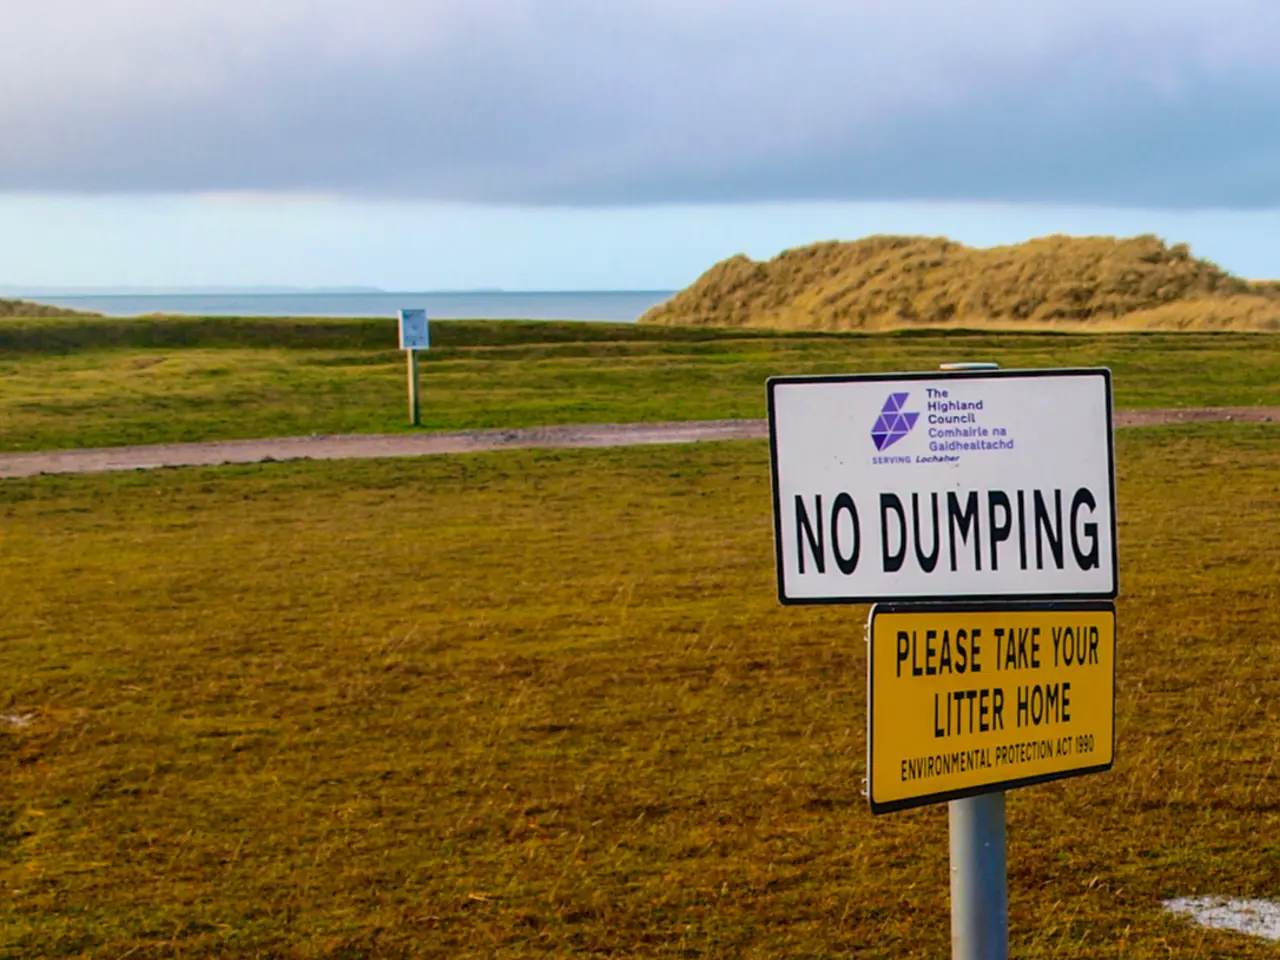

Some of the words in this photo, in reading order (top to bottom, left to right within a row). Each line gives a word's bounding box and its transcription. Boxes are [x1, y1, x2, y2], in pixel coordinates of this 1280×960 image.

[926, 388, 949, 398] The
[927, 400, 983, 412] Highland
[928, 413, 976, 424] Council
[928, 427, 989, 438] Comhairle
[992, 428, 1007, 437] na
[872, 456, 912, 464] SERVING
[794, 491, 861, 576] NO
[879, 487, 1100, 574] DUMPING
[896, 629, 981, 677] PLEASE
[994, 627, 1040, 670] TAKE
[1051, 626, 1099, 667] YOUR
[934, 687, 1005, 738] LITTER
[1016, 682, 1071, 728] HOME
[900, 748, 993, 781] ENVIRONMENTAL
[995, 740, 1053, 767] PROTECTION
[1055, 736, 1073, 756] ACT
[1074, 733, 1095, 754] 1990
